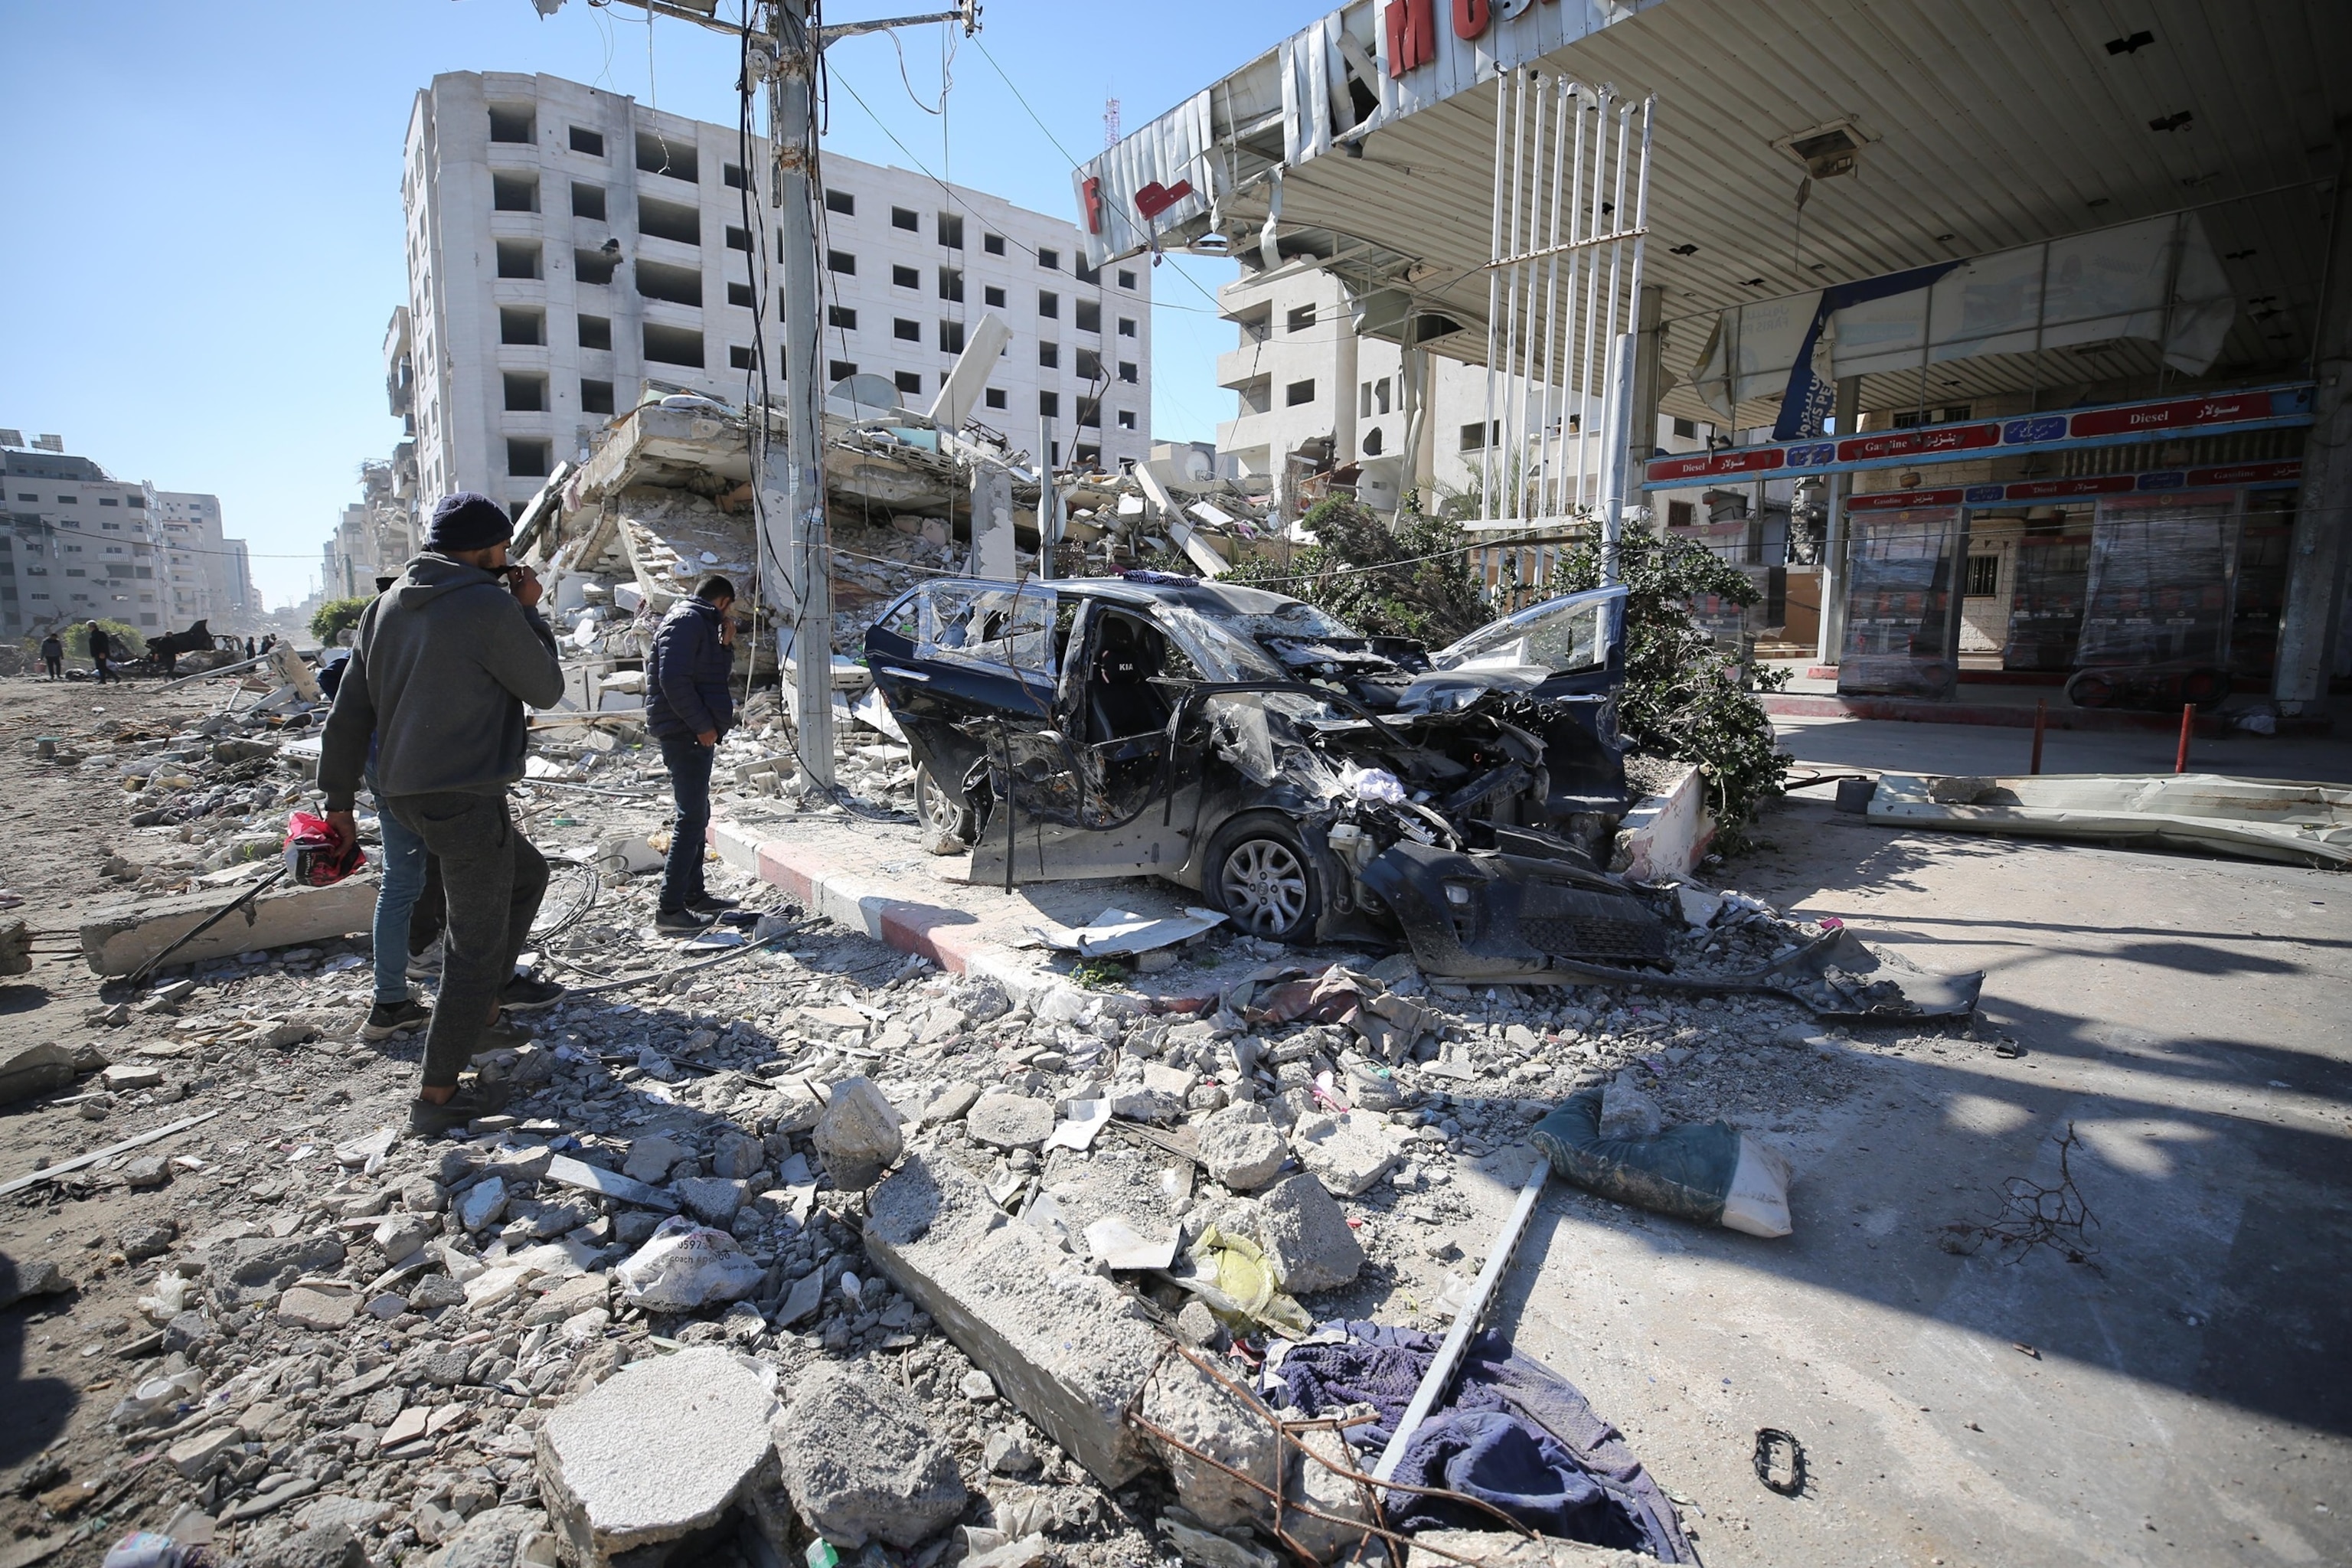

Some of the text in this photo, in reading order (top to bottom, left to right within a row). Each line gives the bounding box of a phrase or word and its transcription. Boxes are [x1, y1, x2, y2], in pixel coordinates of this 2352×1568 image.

[2197, 403, 2239, 419] سولار
[2130, 410, 2168, 425] Diesel
[1683, 462, 1705, 473] Diesel
[1721, 459, 1746, 470] سولار
[2213, 469, 2256, 480] Gasoline
[2034, 485, 2057, 494] Diesel
[2073, 482, 2099, 492] سولار
[1873, 497, 1902, 505] Gasoline
[1913, 494, 1934, 504] بنزين
[669, 1256, 693, 1264] coach
